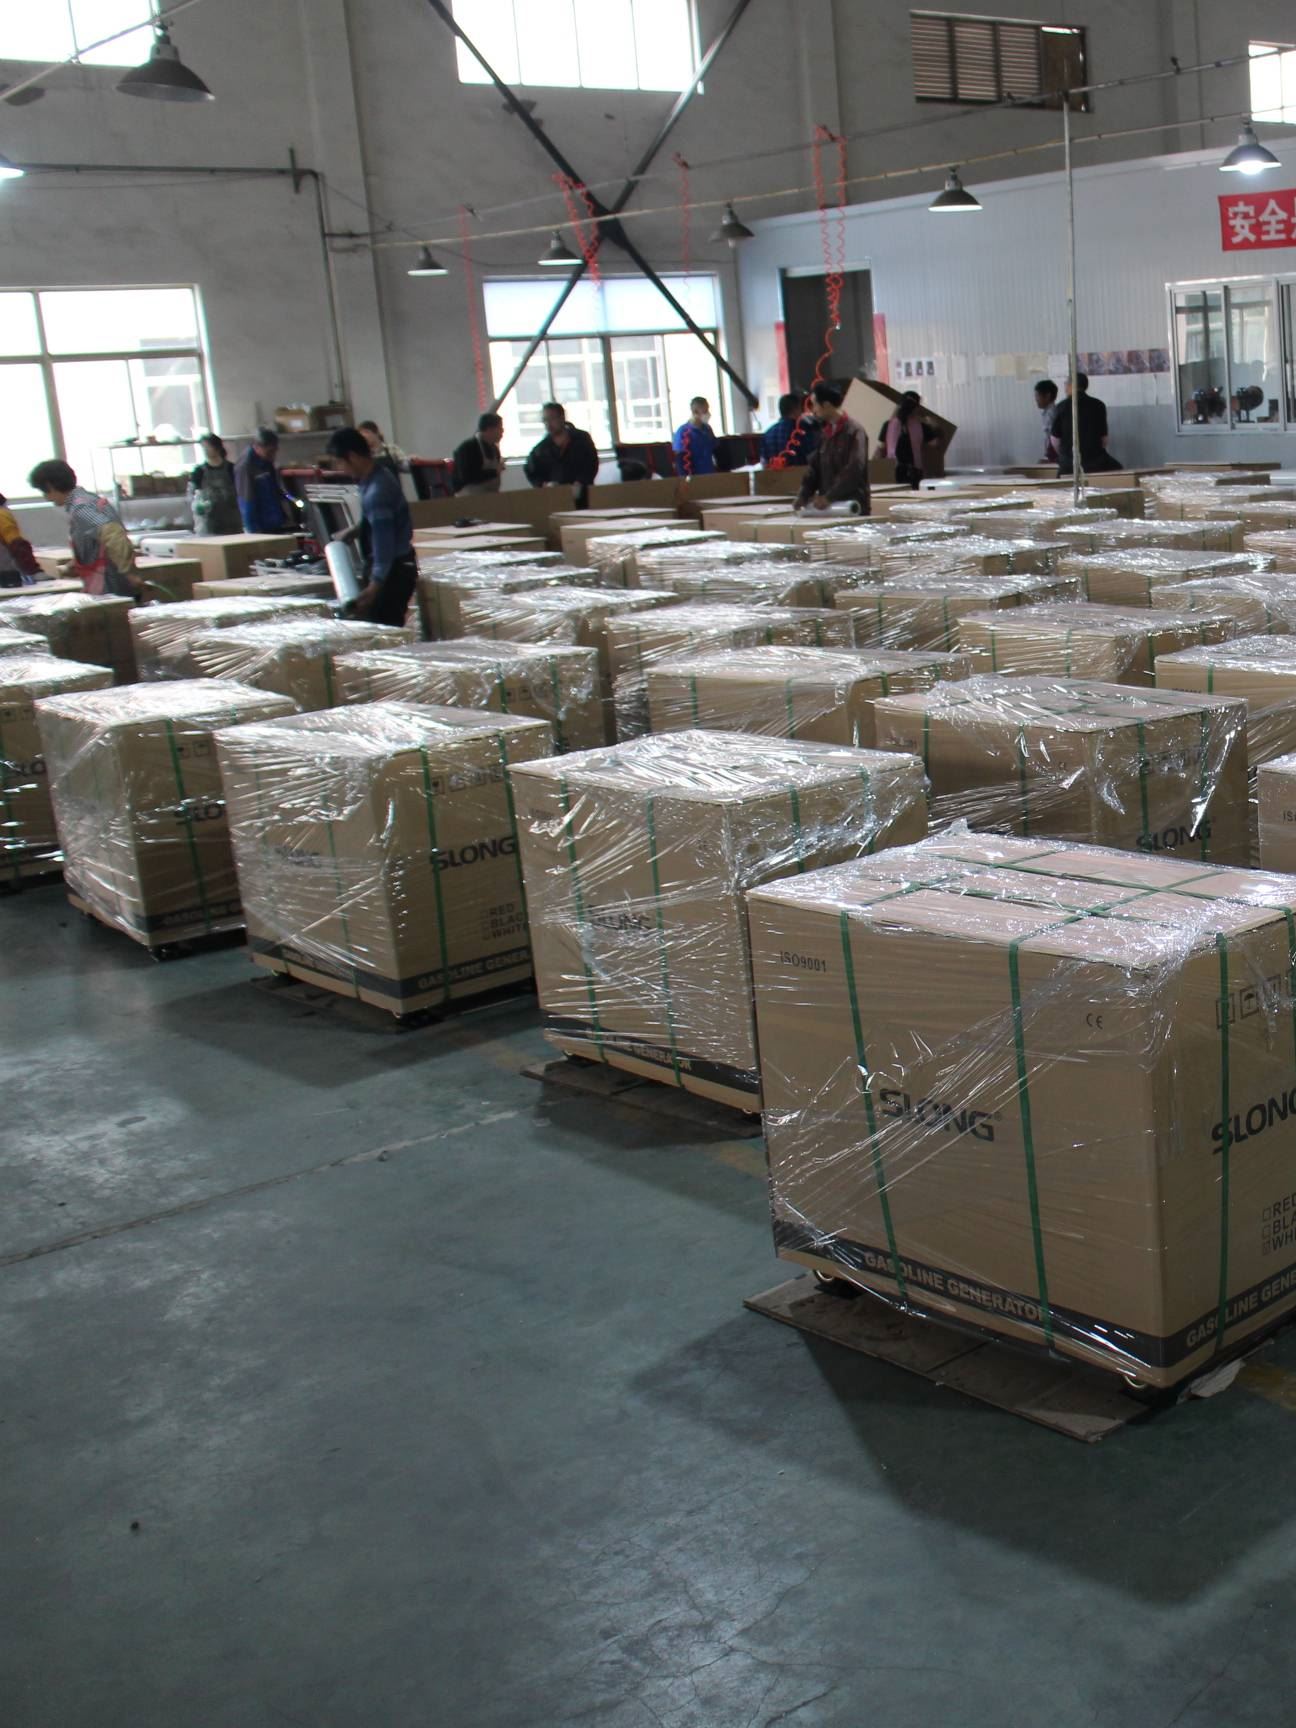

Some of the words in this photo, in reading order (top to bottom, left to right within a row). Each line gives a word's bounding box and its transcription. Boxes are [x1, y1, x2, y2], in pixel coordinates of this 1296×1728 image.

[430, 835, 516, 873] SLONG
[490, 911, 525, 929] BLAC
[780, 951, 827, 973] ISO9001
[1086, 1012, 1103, 1030] CE
[1186, 1293, 1258, 1348] GASLINE
